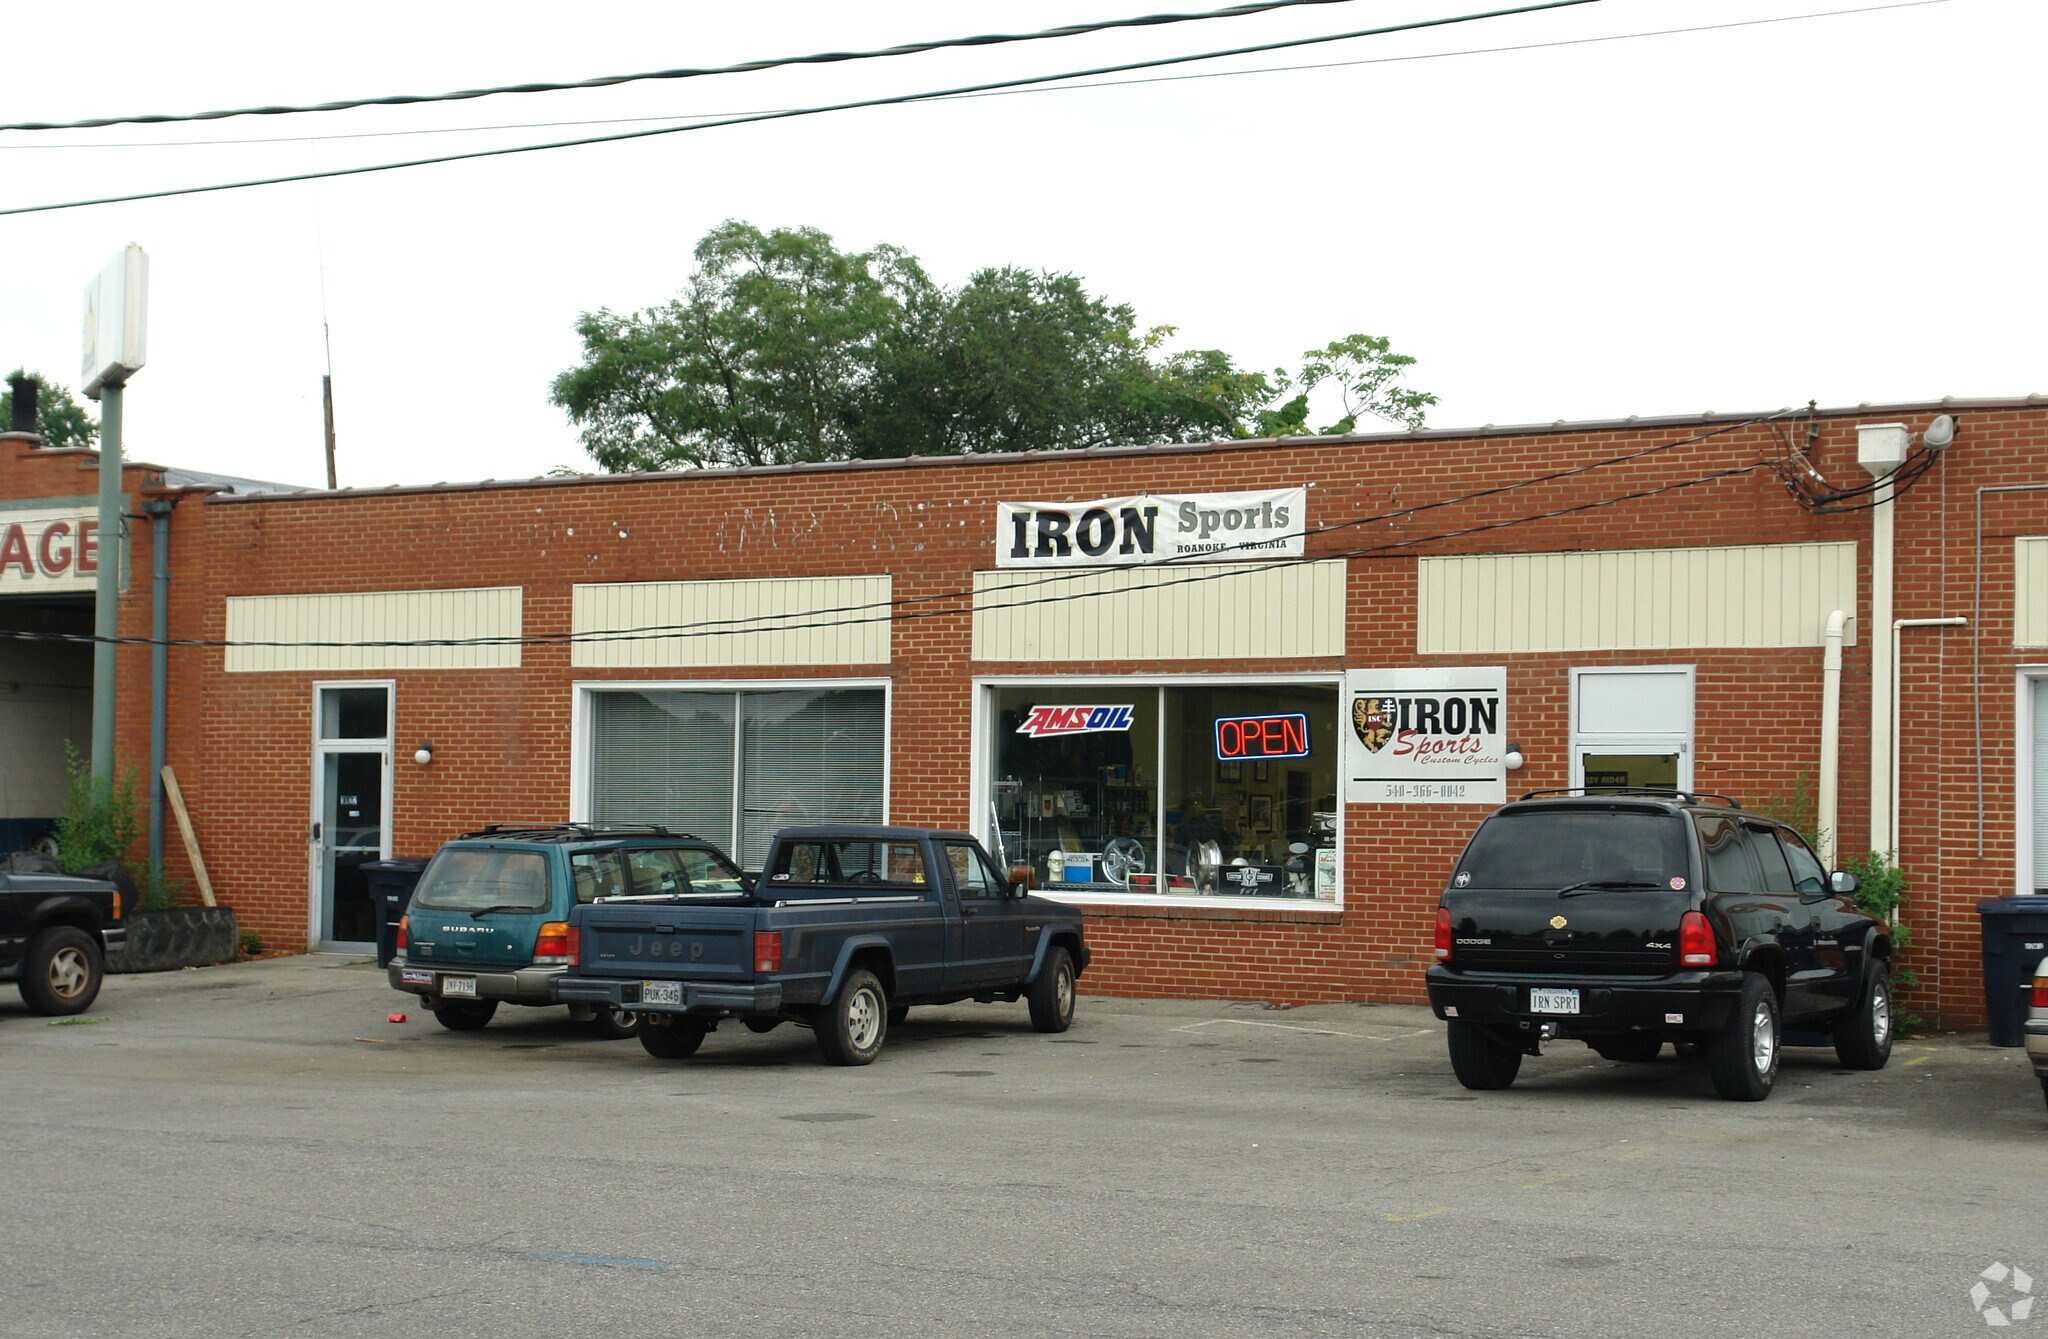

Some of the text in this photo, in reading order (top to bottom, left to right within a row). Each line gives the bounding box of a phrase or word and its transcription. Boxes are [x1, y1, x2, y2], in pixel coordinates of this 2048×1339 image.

[1010, 501, 1290, 558] IRON Sports
[0, 519, 98, 579] AGE
[1239, 539, 1287, 551] VIRGINIA
[1022, 707, 1130, 735] AMSOIL
[1367, 714, 1383, 723] ISC
[1398, 697, 1499, 735] IRON
[1220, 718, 1305, 756] OPEN
[1393, 729, 1483, 762] Sports
[1420, 755, 1499, 765] Custom Cycles
[1385, 784, 1466, 798] 540-366-0042
[629, 935, 704, 961] Jeep
[644, 988, 679, 1002] PUK-346
[1533, 995, 1578, 1010] IRN SPRT
